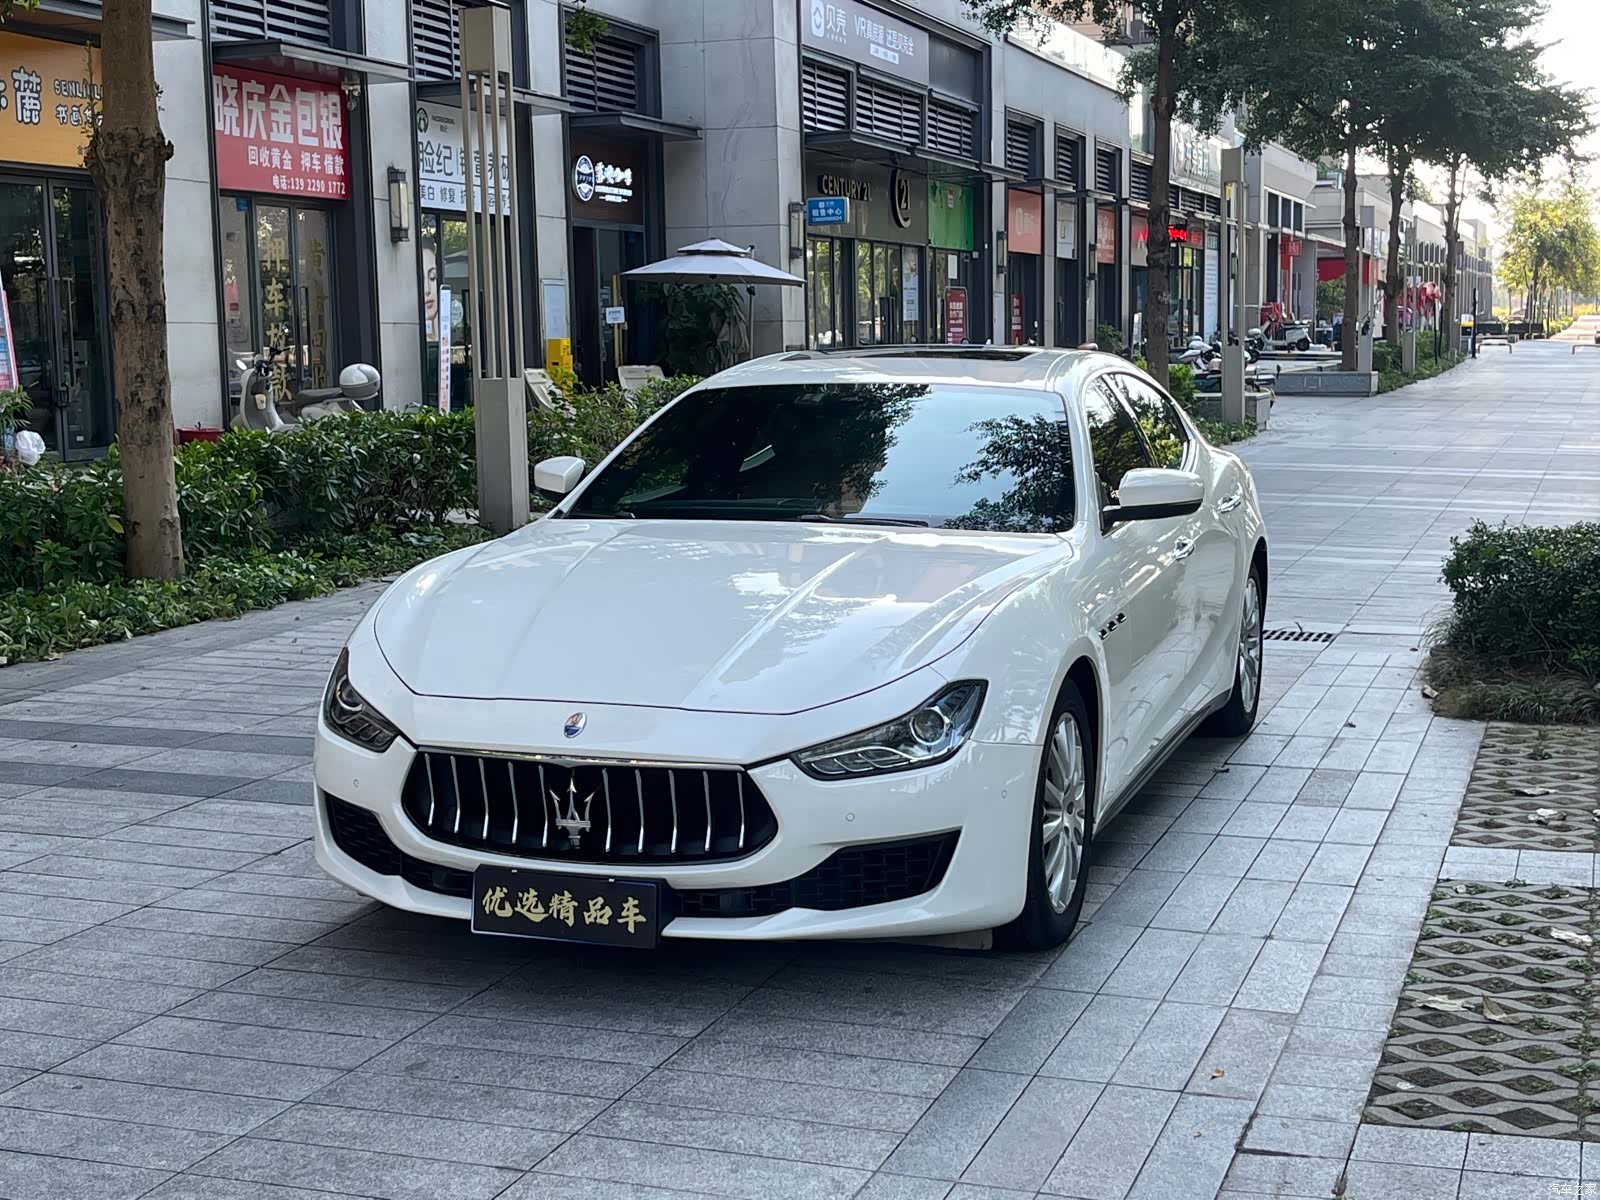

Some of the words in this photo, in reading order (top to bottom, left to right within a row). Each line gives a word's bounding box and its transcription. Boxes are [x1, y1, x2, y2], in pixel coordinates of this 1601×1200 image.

[826, 4, 847, 36] 贝壳
[0, 66, 42, 125] 麓
[212, 74, 344, 150] 晓庆金包银
[248, 145, 293, 170] 回收黄金
[300, 150, 322, 174] 押车
[324, 153, 345, 176] 借款
[307, 178, 326, 192] 2290
[328, 181, 346, 194] 1772
[820, 174, 862, 200] CENTURY
[481, 886, 648, 935] 优选精品车
